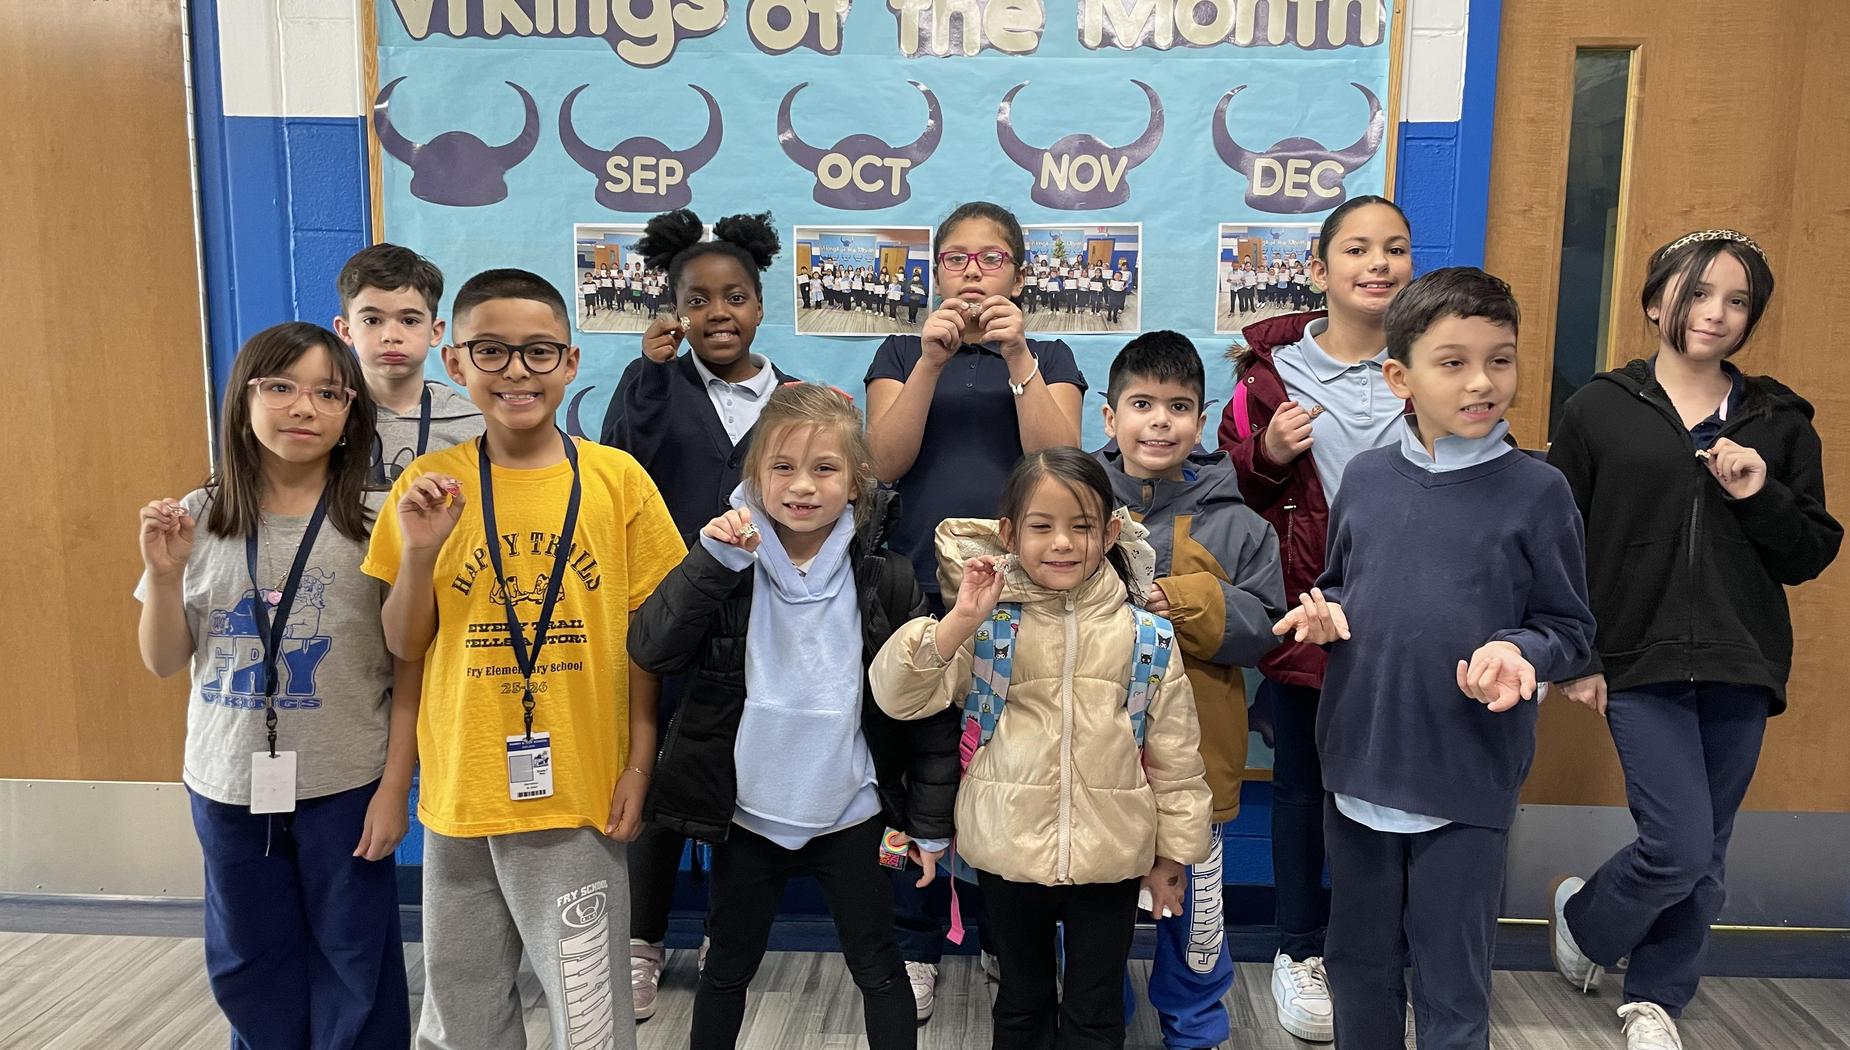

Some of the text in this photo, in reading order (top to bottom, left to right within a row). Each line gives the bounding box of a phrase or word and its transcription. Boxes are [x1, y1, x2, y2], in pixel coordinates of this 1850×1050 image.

[605, 155, 685, 196] SEP
[817, 154, 912, 196] OCT
[1040, 153, 1129, 194] NOV
[1252, 157, 1346, 198] DEC
[451, 533, 519, 596] HAPY
[201, 634, 333, 696] FRY
[467, 667, 484, 679] Fry
[550, 661, 583, 673] School
[556, 879, 609, 908] FRY SCHOOL
